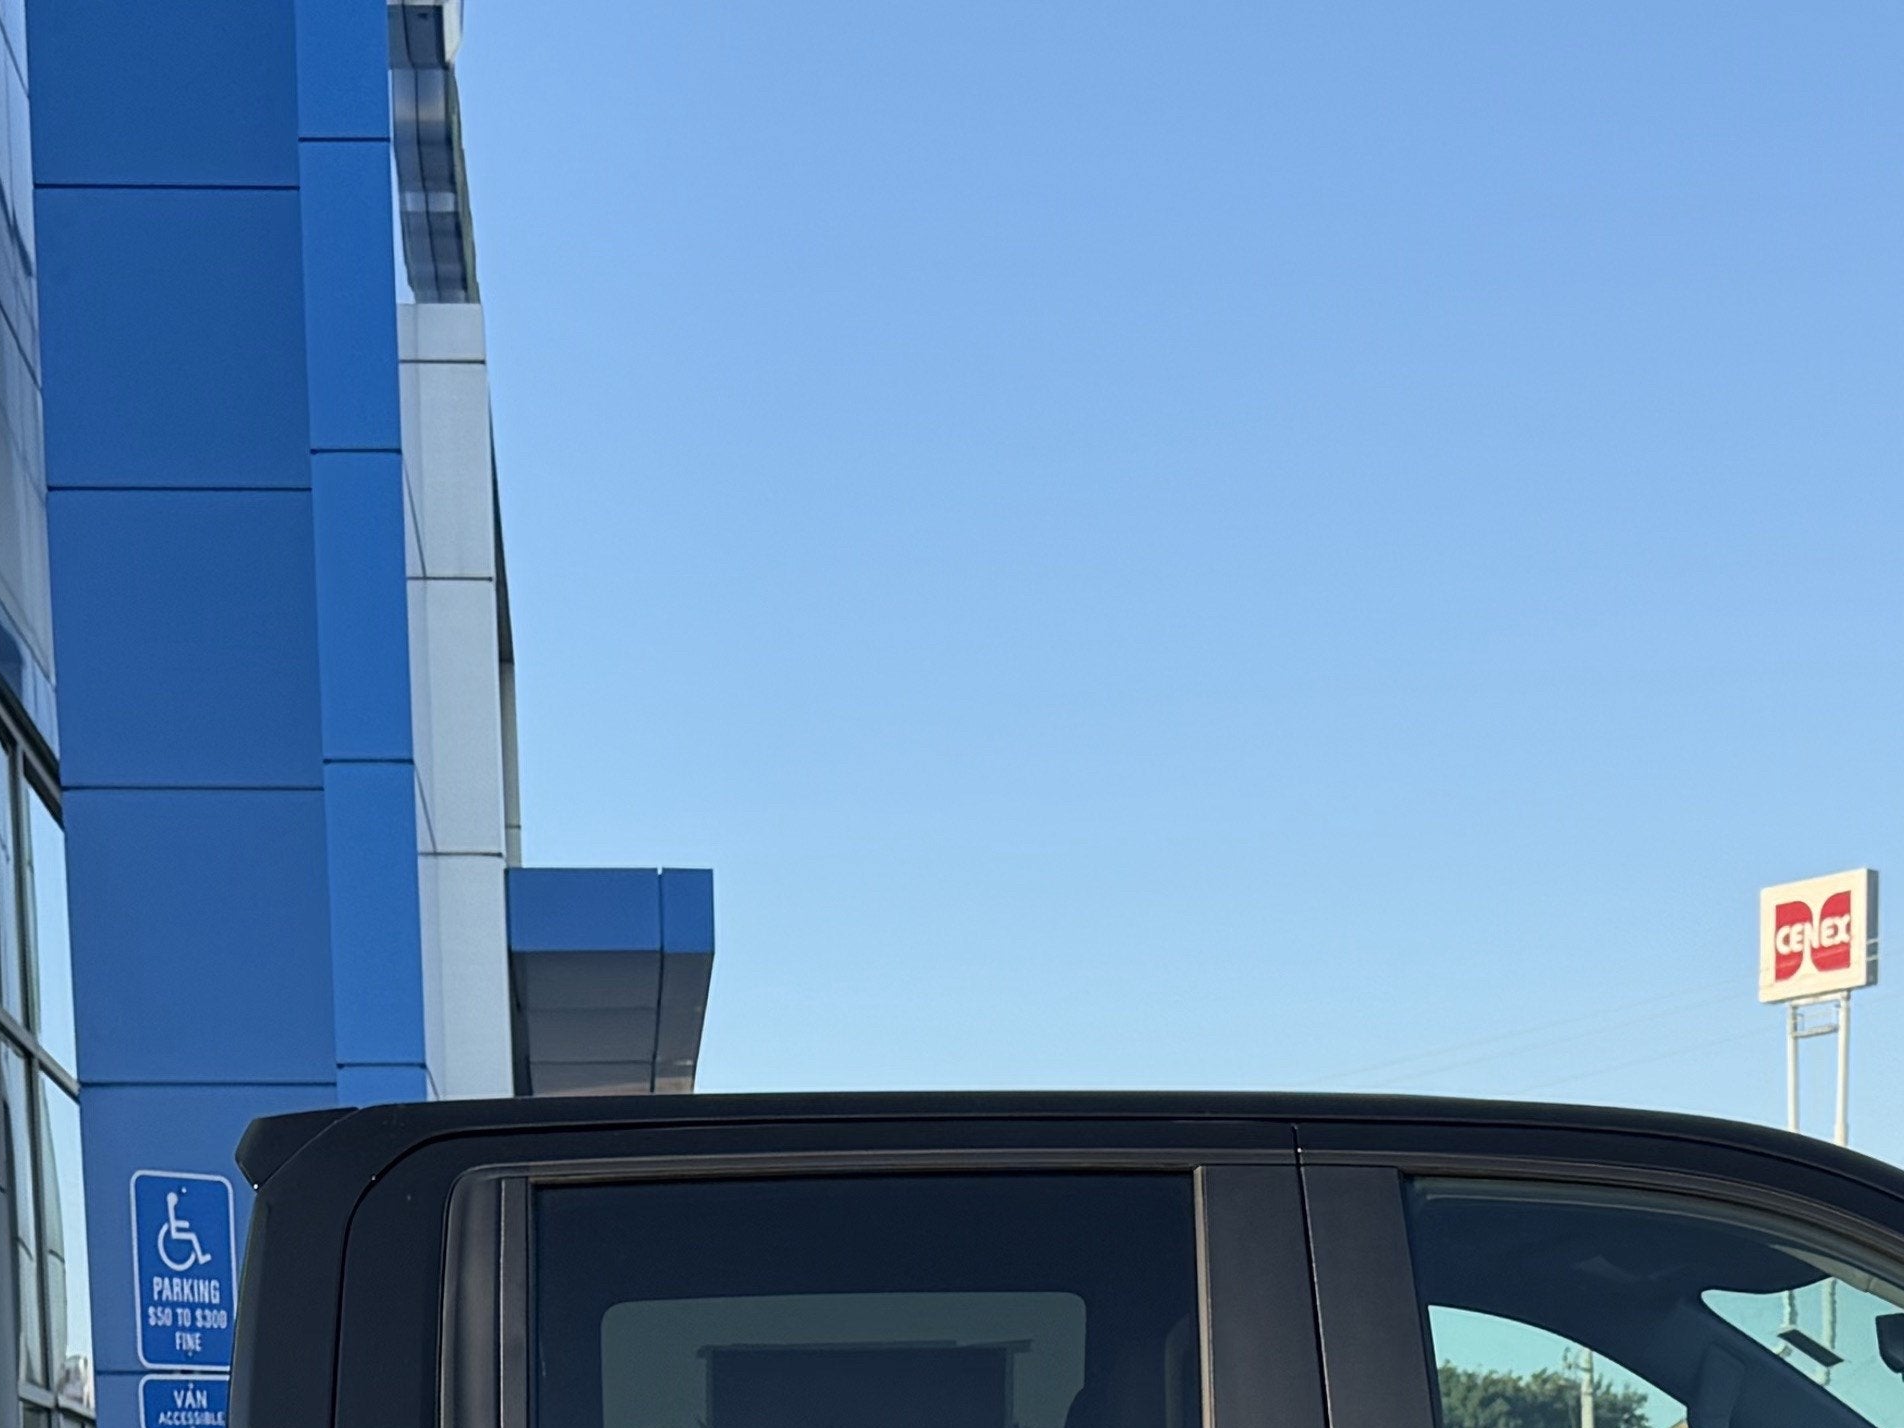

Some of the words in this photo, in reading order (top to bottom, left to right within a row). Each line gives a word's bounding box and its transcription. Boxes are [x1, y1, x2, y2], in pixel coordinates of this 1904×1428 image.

[1777, 914, 1851, 955] CENEX
[153, 1275, 221, 1305] PARKING
[148, 1305, 173, 1327] $50
[176, 1307, 192, 1327] TO
[195, 1308, 228, 1329] $300
[175, 1331, 202, 1352] FINE
[173, 1389, 208, 1410] VAN
[158, 1410, 226, 1427] ACCESSIBLE
